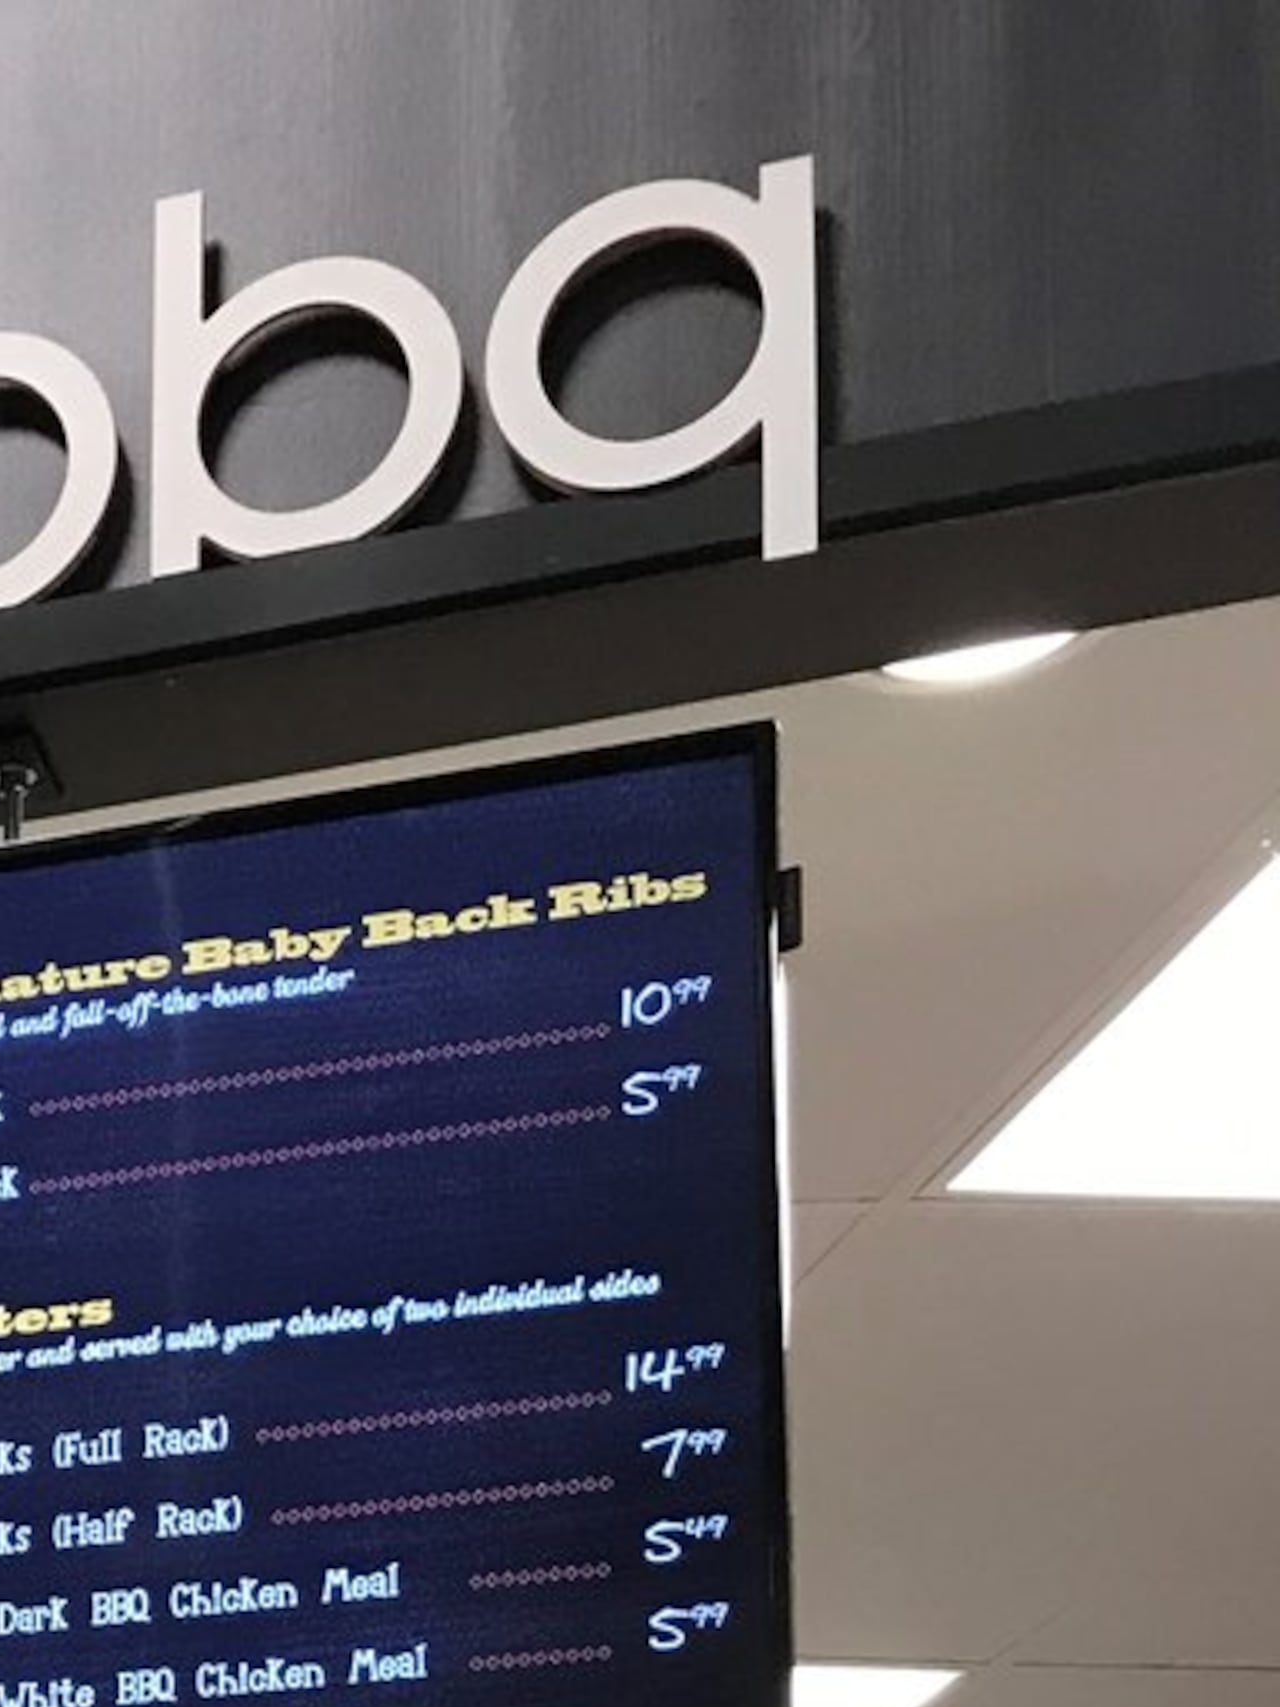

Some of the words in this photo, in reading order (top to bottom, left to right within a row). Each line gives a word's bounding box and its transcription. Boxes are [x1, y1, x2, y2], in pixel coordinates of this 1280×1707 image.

[181, 925, 352, 976] Baby
[360, 895, 538, 948] Back
[546, 868, 708, 919] Ribs
[10, 1006, 56, 1038] and
[60, 984, 268, 1038] fall-off-the-bone
[273, 966, 354, 995] tender
[27, 1338, 73, 1368] and
[79, 1324, 161, 1361] served
[167, 1320, 218, 1352] with
[224, 1320, 282, 1353] your
[288, 1303, 367, 1338] choice
[372, 1297, 399, 1338] of
[402, 1298, 446, 1324] two
[454, 1276, 583, 1316] individual
[588, 1270, 661, 1301] sides
[53, 1431, 124, 1469] (Full
[144, 1416, 229, 1457] Rack)
[53, 1508, 134, 1548] (Half
[156, 1496, 243, 1535] Rack)
[91, 1590, 149, 1623] BBQ
[170, 1578, 298, 1616] Chicken
[321, 1564, 399, 1602] Meal
[117, 1668, 177, 1705] BBQ
[196, 1659, 325, 1698] Chicken
[349, 1643, 429, 1684] Meal
